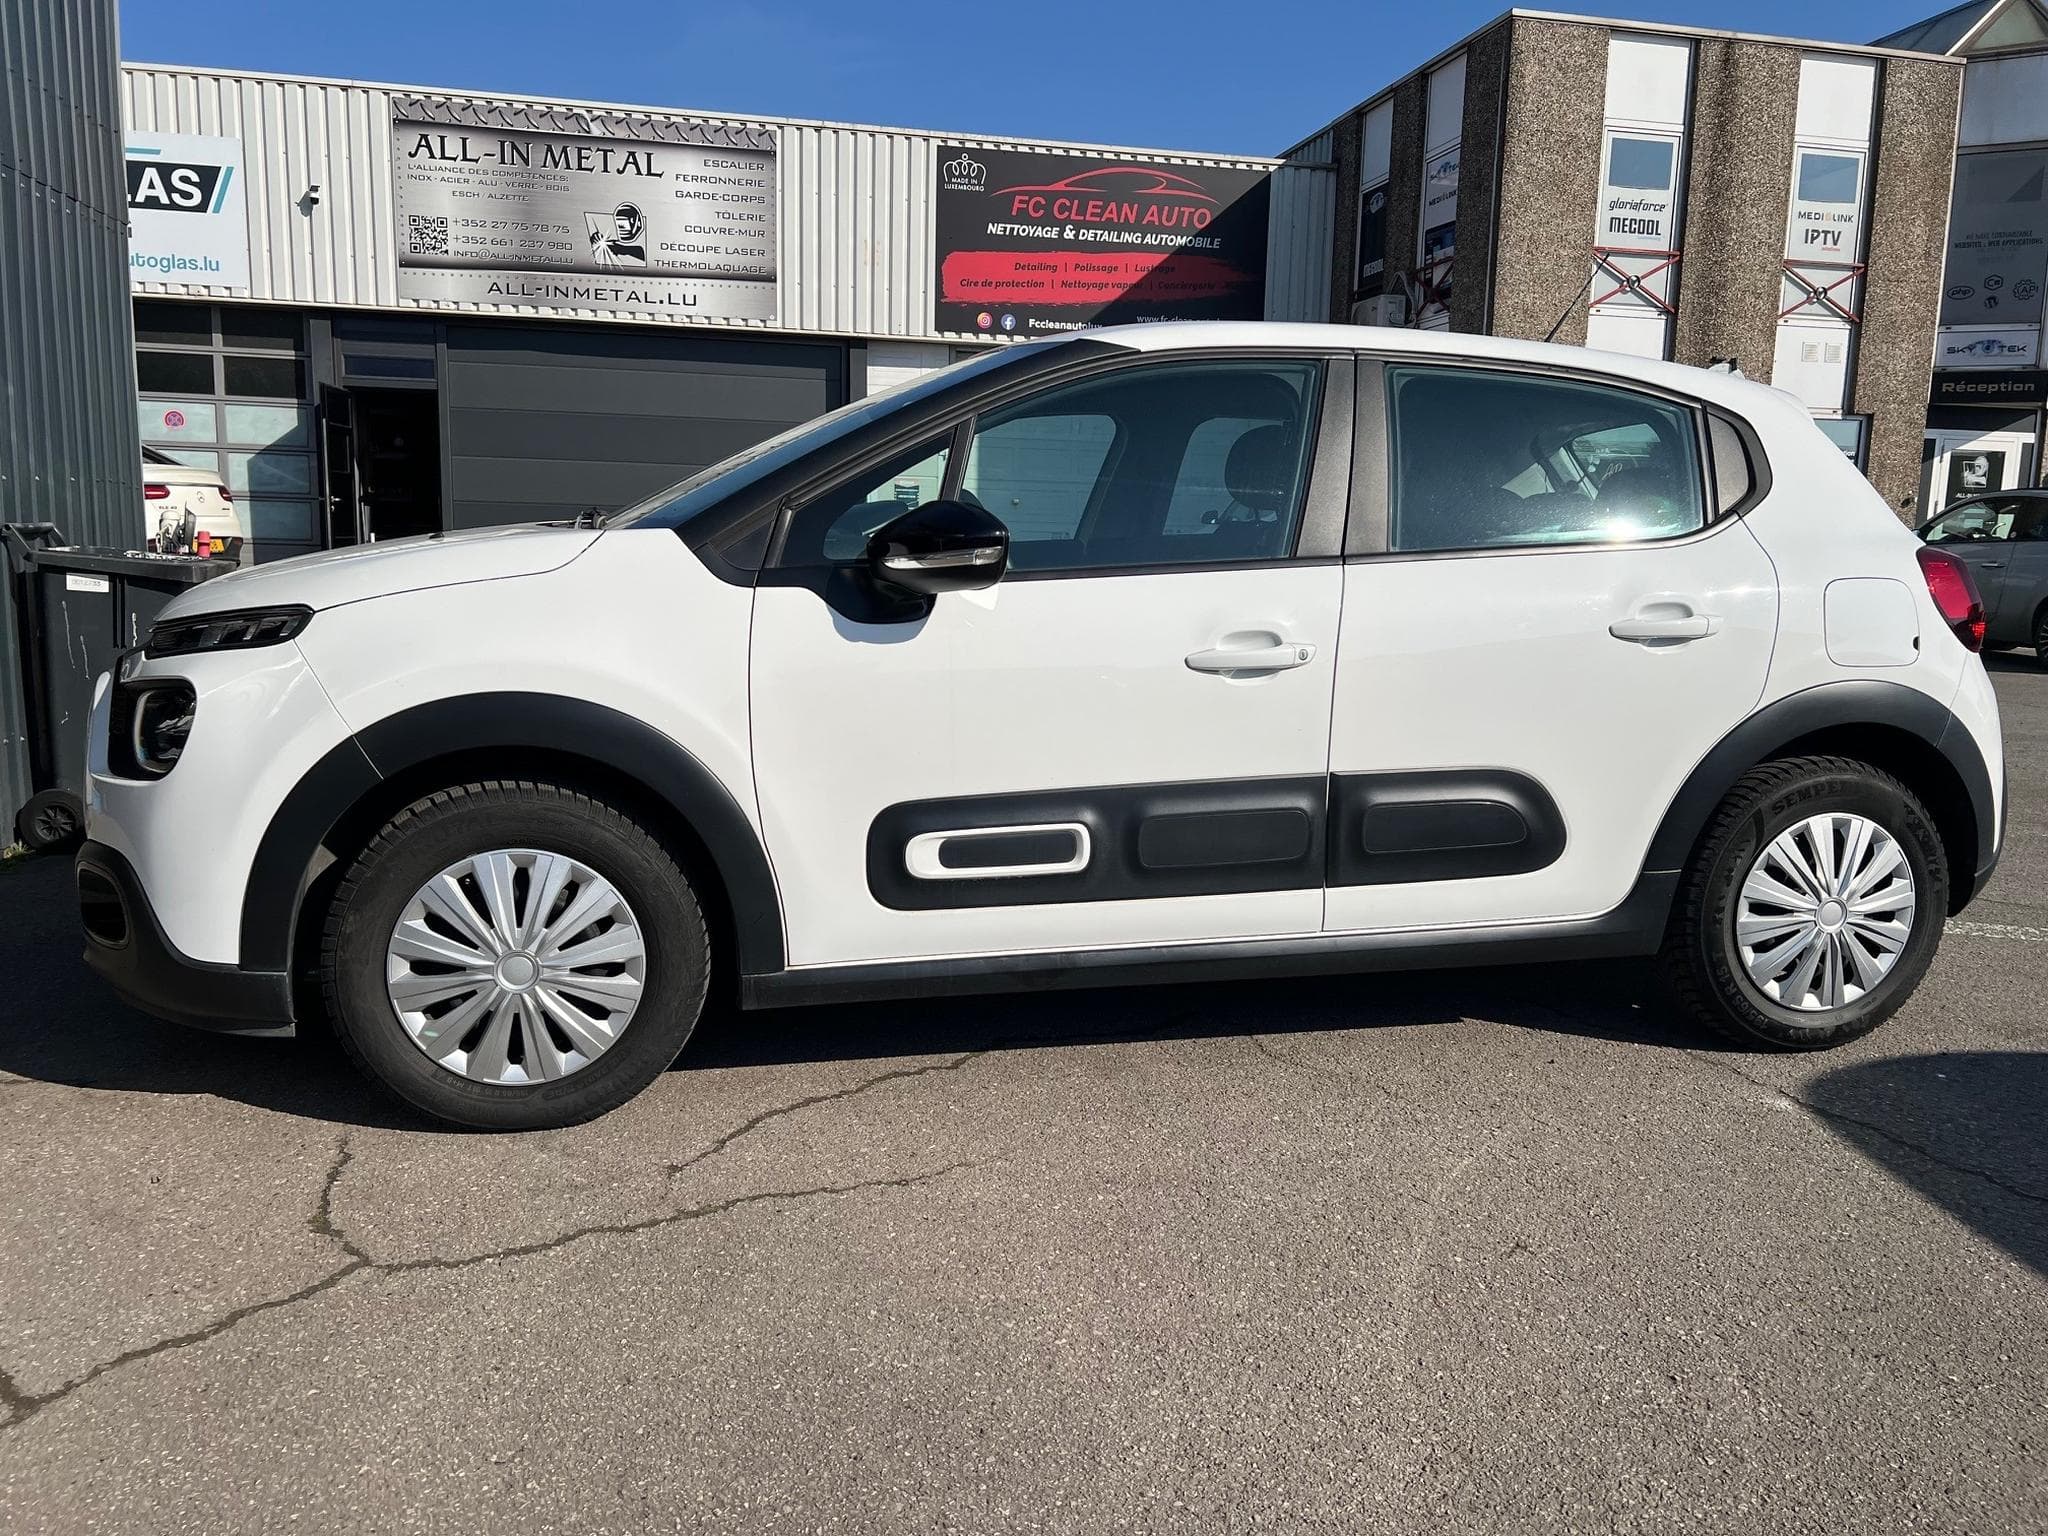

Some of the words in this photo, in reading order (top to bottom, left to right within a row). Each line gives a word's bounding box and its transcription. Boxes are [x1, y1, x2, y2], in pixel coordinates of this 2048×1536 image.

[408, 133, 532, 167] ALL-IN
[541, 143, 664, 178] METAL
[468, 168, 489, 176] DES
[703, 159, 765, 171] ESCALIER
[407, 174, 432, 182] INOX
[440, 177, 470, 185] ACIER
[478, 179, 498, 187] ALU
[505, 181, 538, 190] VERRE
[546, 184, 570, 192] BOIS
[675, 174, 765, 188] FERRONNERIE
[944, 183, 985, 192] LUXEMBOURG
[452, 190, 480, 198] ESCH
[487, 193, 529, 201] ALZETTE
[675, 190, 766, 204] GARDE-CORPS
[1609, 197, 1666, 212] gloriaforce
[715, 210, 766, 222] TÔLERIE
[1011, 195, 1046, 218] FC
[1053, 197, 1138, 224] CLEAN
[1142, 203, 1212, 229] AUTO
[453, 218, 487, 228] +352
[491, 221, 508, 230] 27
[511, 222, 529, 231] 75
[532, 223, 550, 232] 78
[553, 225, 570, 234] 75
[684, 225, 765, 238] COUVRE-MUR
[1609, 217, 1661, 235] MECOOL
[453, 234, 487, 245] +352
[491, 237, 514, 246] 661
[520, 239, 544, 249] 237
[548, 241, 573, 250] 980
[987, 222, 1060, 239] NETTOYAGE
[1063, 225, 1077, 240] &
[1078, 228, 1141, 244] DETAILING
[1143, 232, 1221, 248] AUTOMOBILE
[1804, 228, 1842, 246] IPTV
[660, 241, 721, 254] DÉCOUPE
[725, 246, 765, 257] LASER
[654, 260, 766, 274] THERMOLAQUAGE
[1014, 262, 1058, 273] Detailing
[1074, 263, 1119, 274] Polissage
[1135, 263, 1175, 273] Lustrage
[960, 279, 979, 288] Cire
[981, 279, 992, 288] de
[995, 279, 1045, 290] protection
[1061, 280, 1110, 291] Nettoyage
[487, 281, 697, 306] ALL-INMETAL.LU
[1942, 381, 2035, 394] Réception
